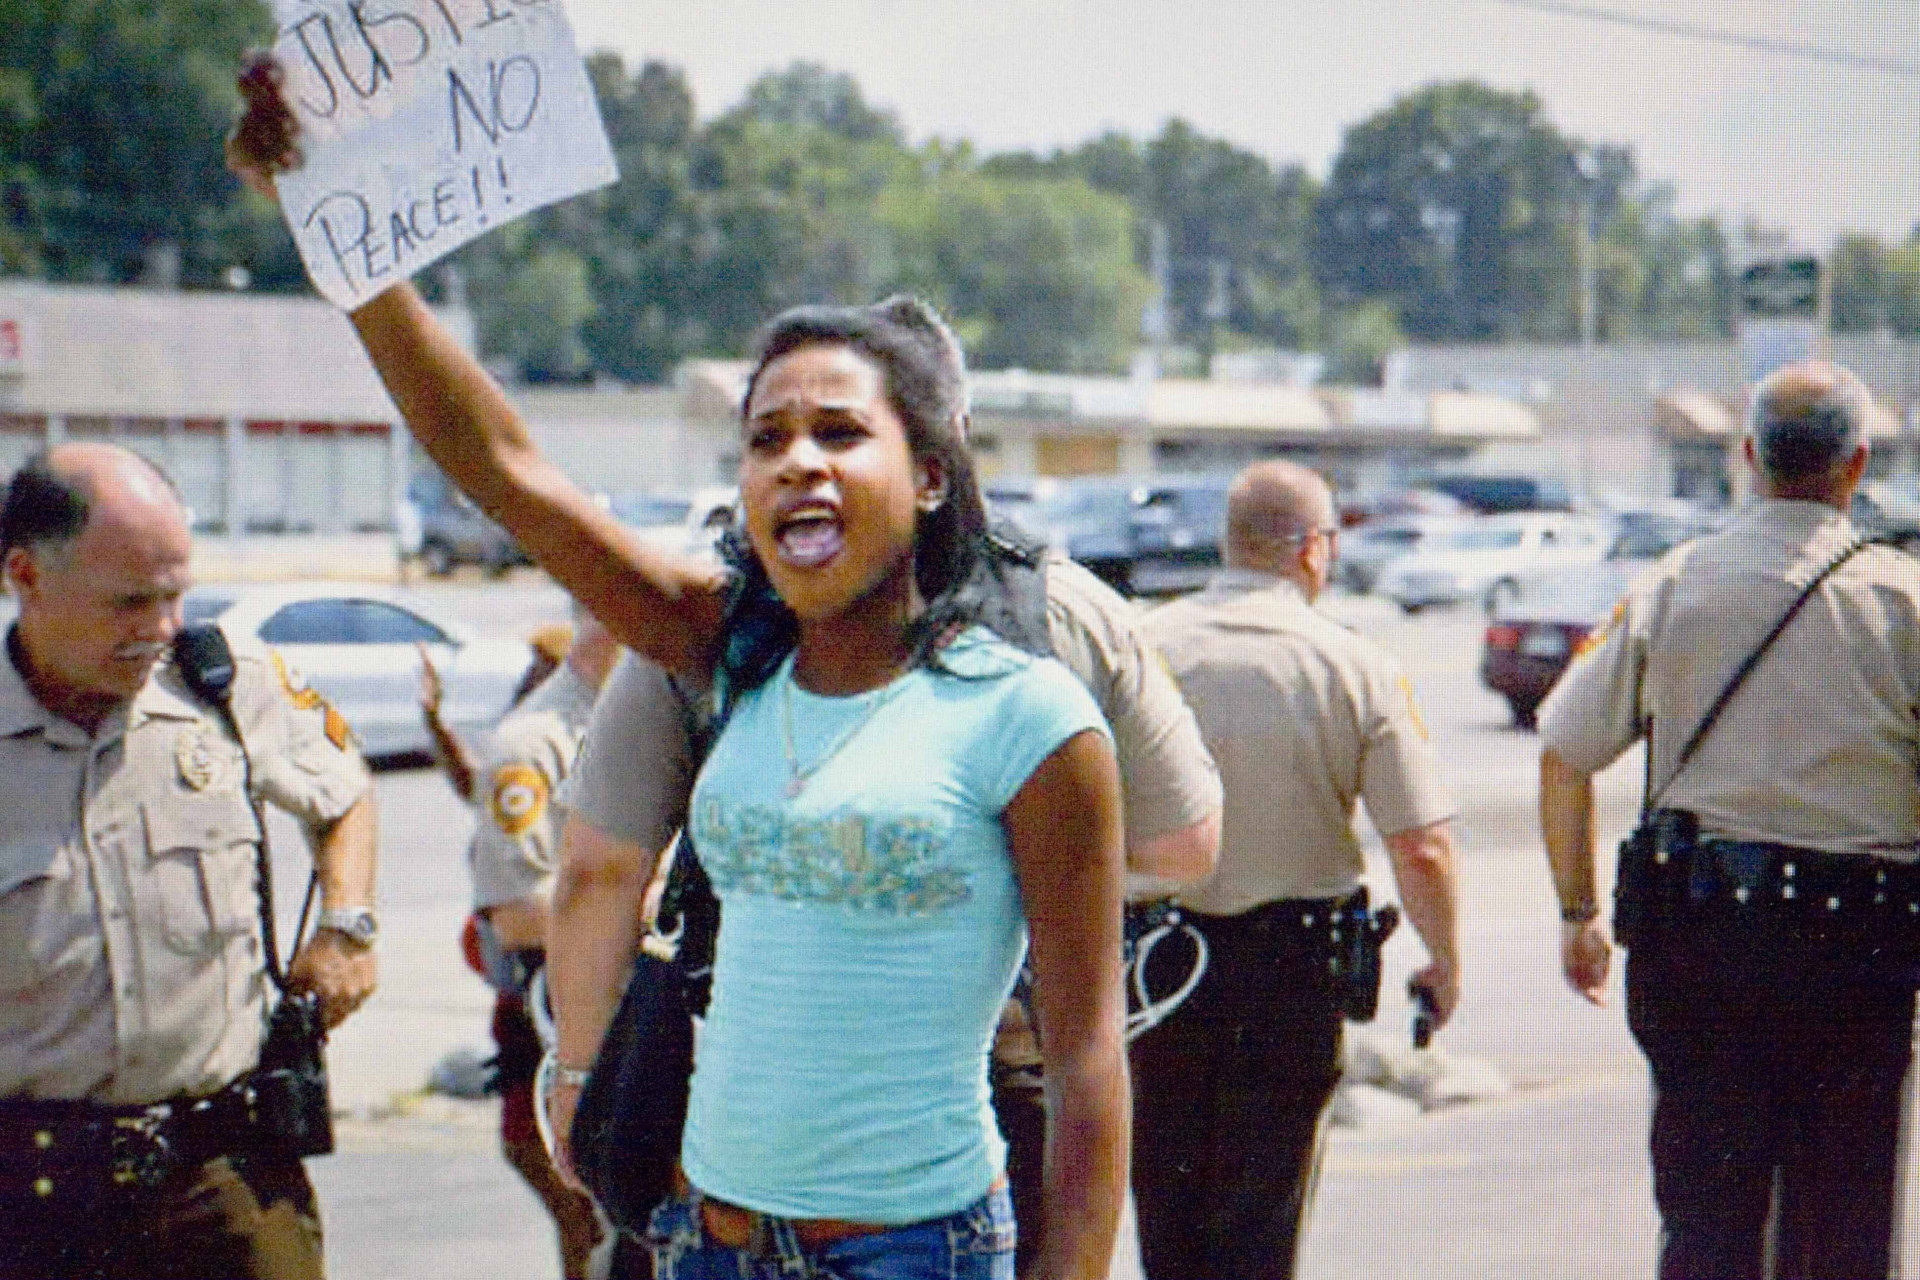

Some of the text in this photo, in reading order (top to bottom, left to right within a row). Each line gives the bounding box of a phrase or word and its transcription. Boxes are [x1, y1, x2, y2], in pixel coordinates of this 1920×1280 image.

[284, 0, 556, 118] JUS
[447, 54, 541, 153] NO
[304, 157, 513, 296] PEACE!!
